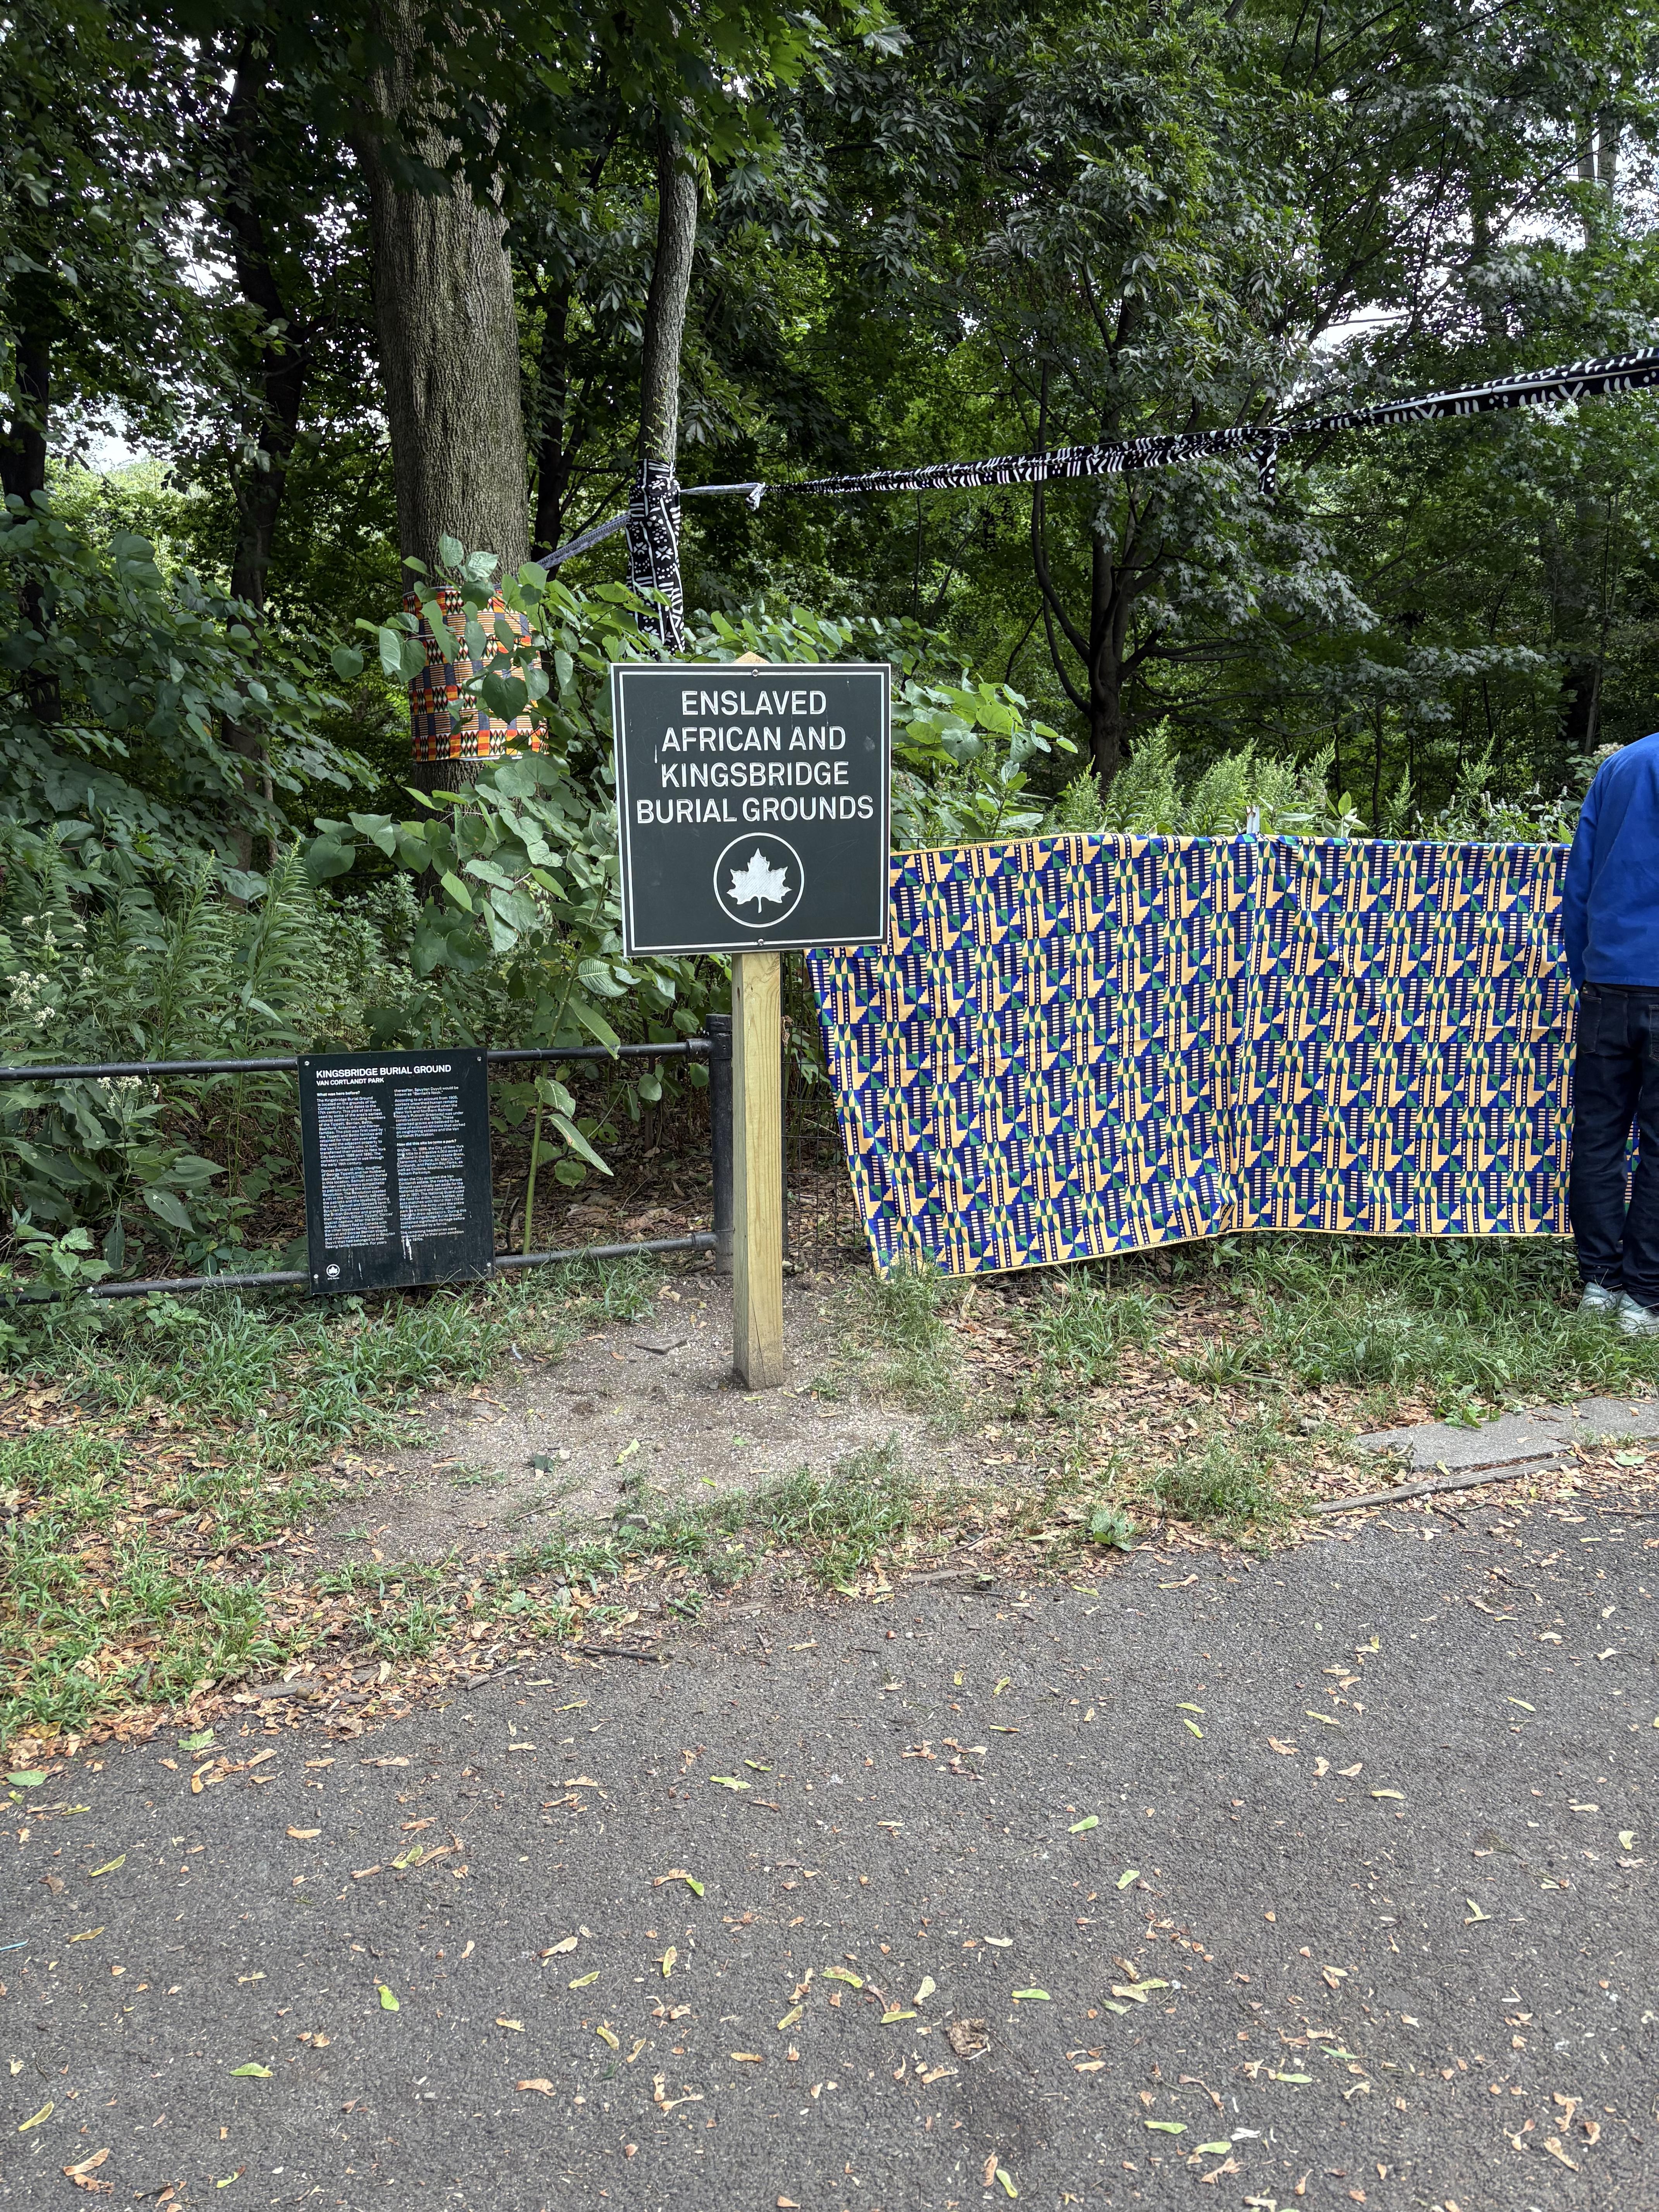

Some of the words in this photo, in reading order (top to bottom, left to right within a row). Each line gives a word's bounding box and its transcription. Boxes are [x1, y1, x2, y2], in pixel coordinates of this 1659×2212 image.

[682, 690, 826, 716] ENSLAVED
[661, 727, 781, 752] AFRICAN
[789, 726, 846, 750] AND
[661, 761, 849, 788] KINGSBRIDGE
[637, 798, 737, 824] BURIAL
[743, 795, 874, 822] GROUNDS
[316, 1068, 378, 1078] KINGSBRIDGE
[380, 1066, 412, 1075] BURIAL
[414, 1065, 451, 1073] GROUND
